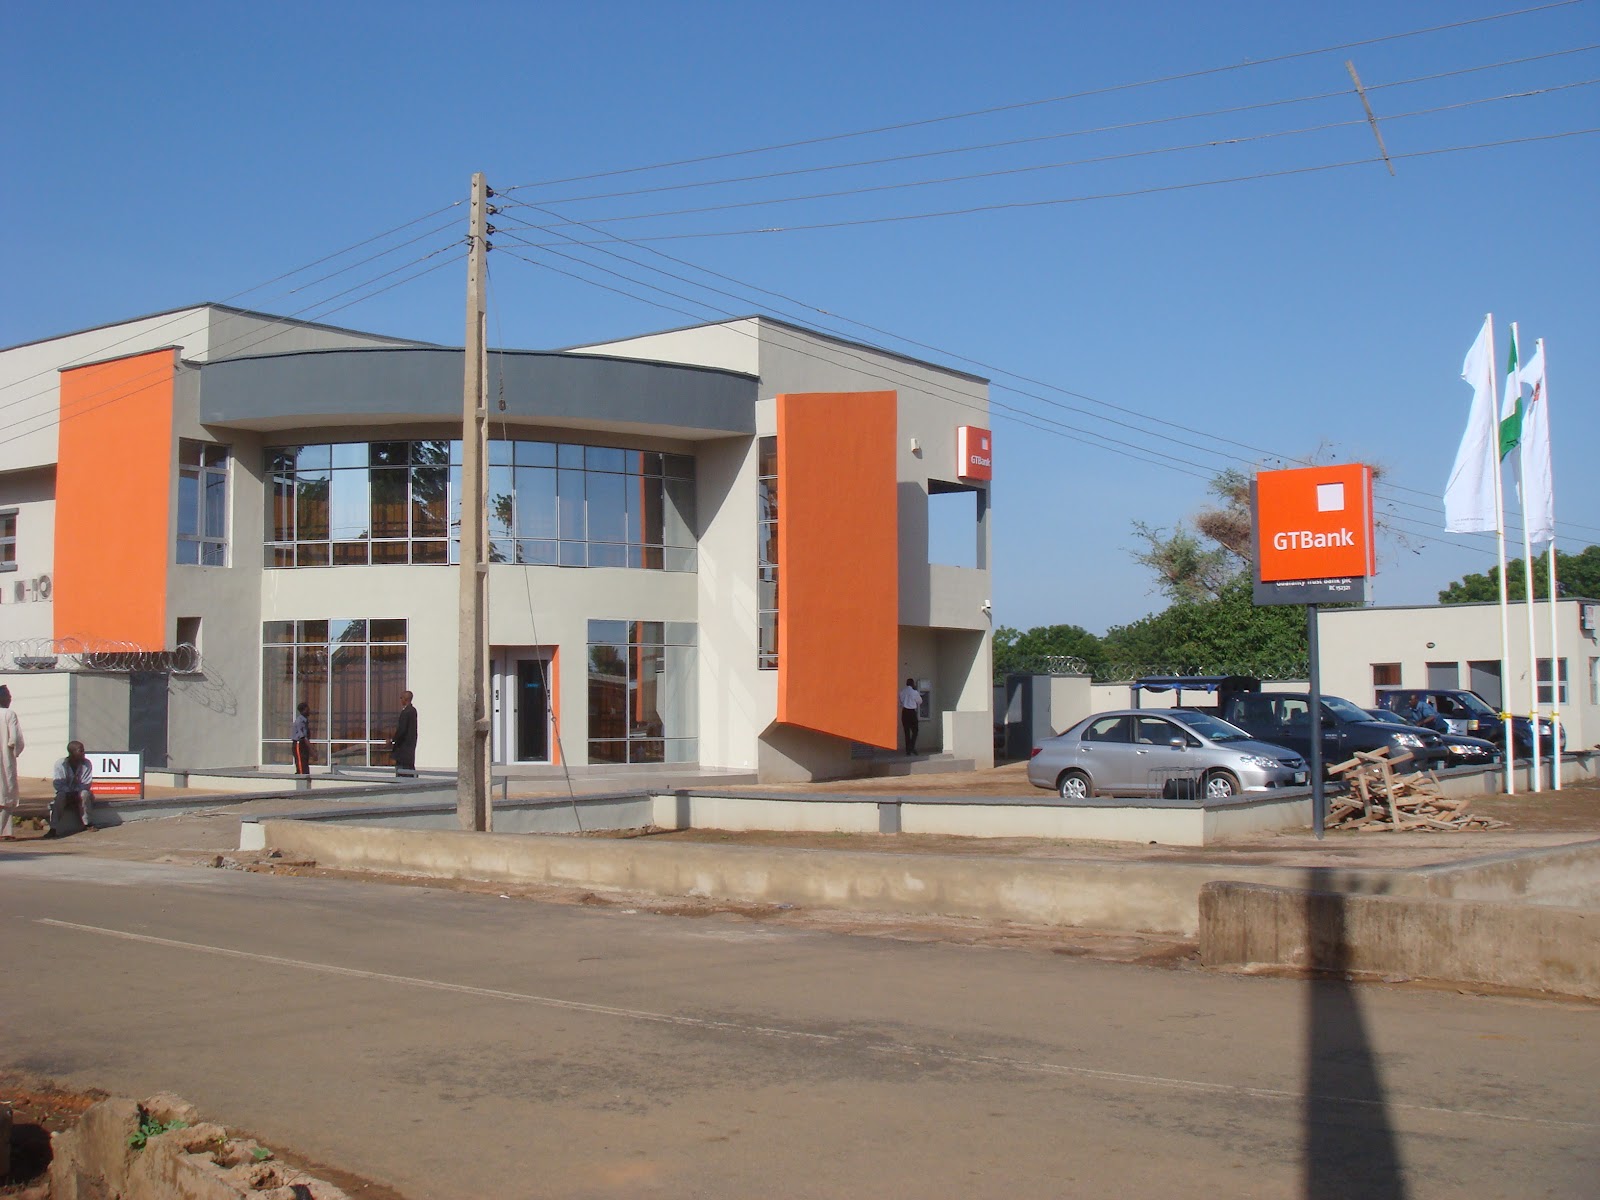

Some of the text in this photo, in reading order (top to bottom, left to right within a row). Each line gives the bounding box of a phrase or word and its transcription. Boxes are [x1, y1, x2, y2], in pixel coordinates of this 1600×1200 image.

[970, 455, 991, 467] GTBank
[1273, 527, 1355, 551] GTBank
[102, 758, 121, 772] IN
